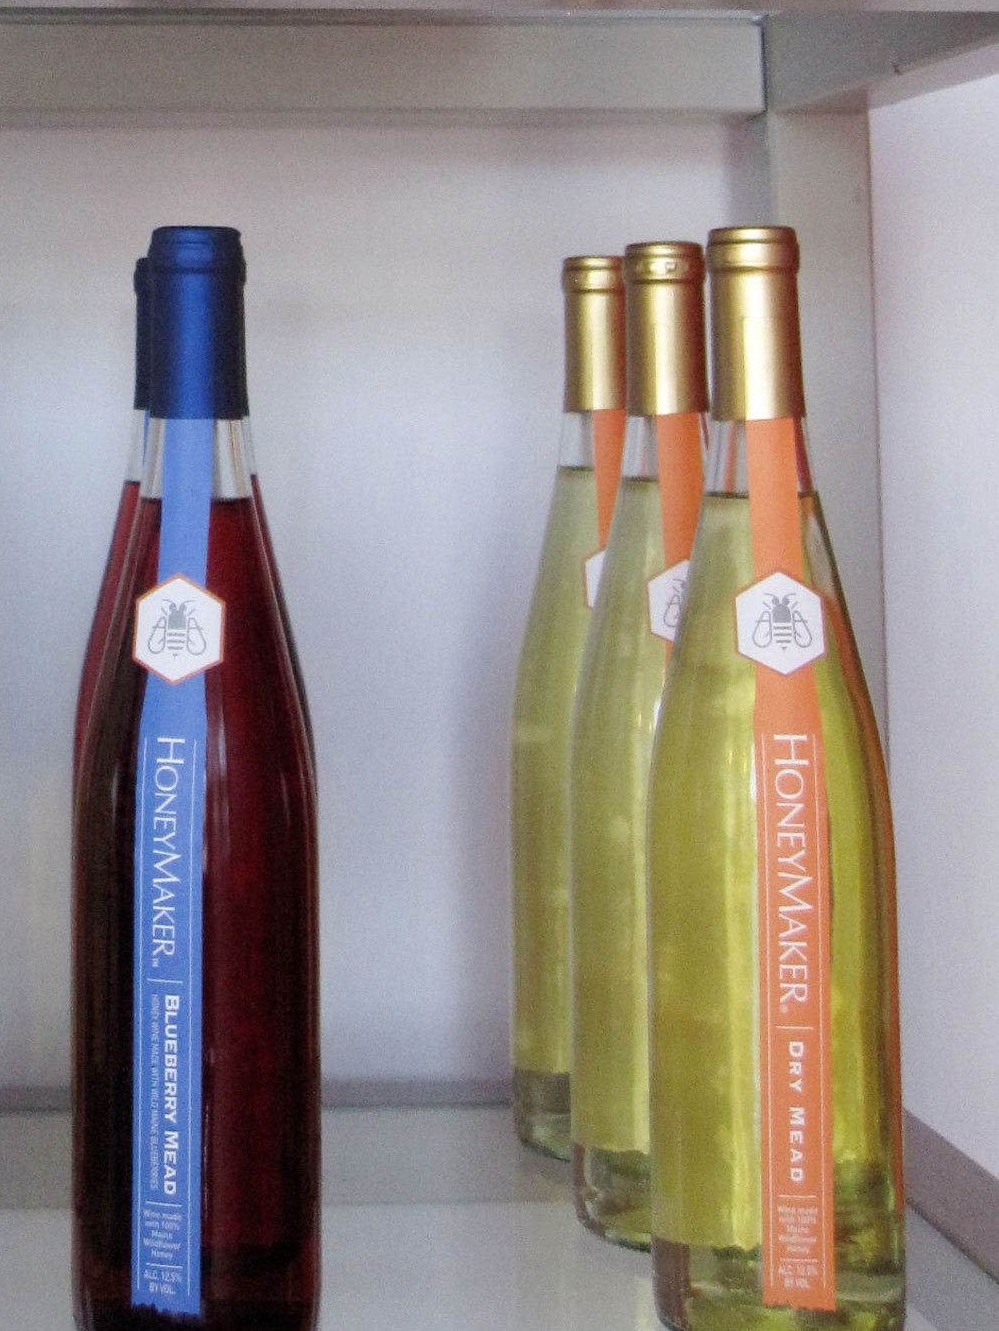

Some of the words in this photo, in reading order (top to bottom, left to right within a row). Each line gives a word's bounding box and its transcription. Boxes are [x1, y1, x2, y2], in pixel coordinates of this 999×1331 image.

[164, 995, 180, 1124] BLUEBERRY
[789, 1041, 804, 1092] DRY
[163, 1131, 179, 1195] MEAD
[789, 1107, 806, 1183] MEAD
